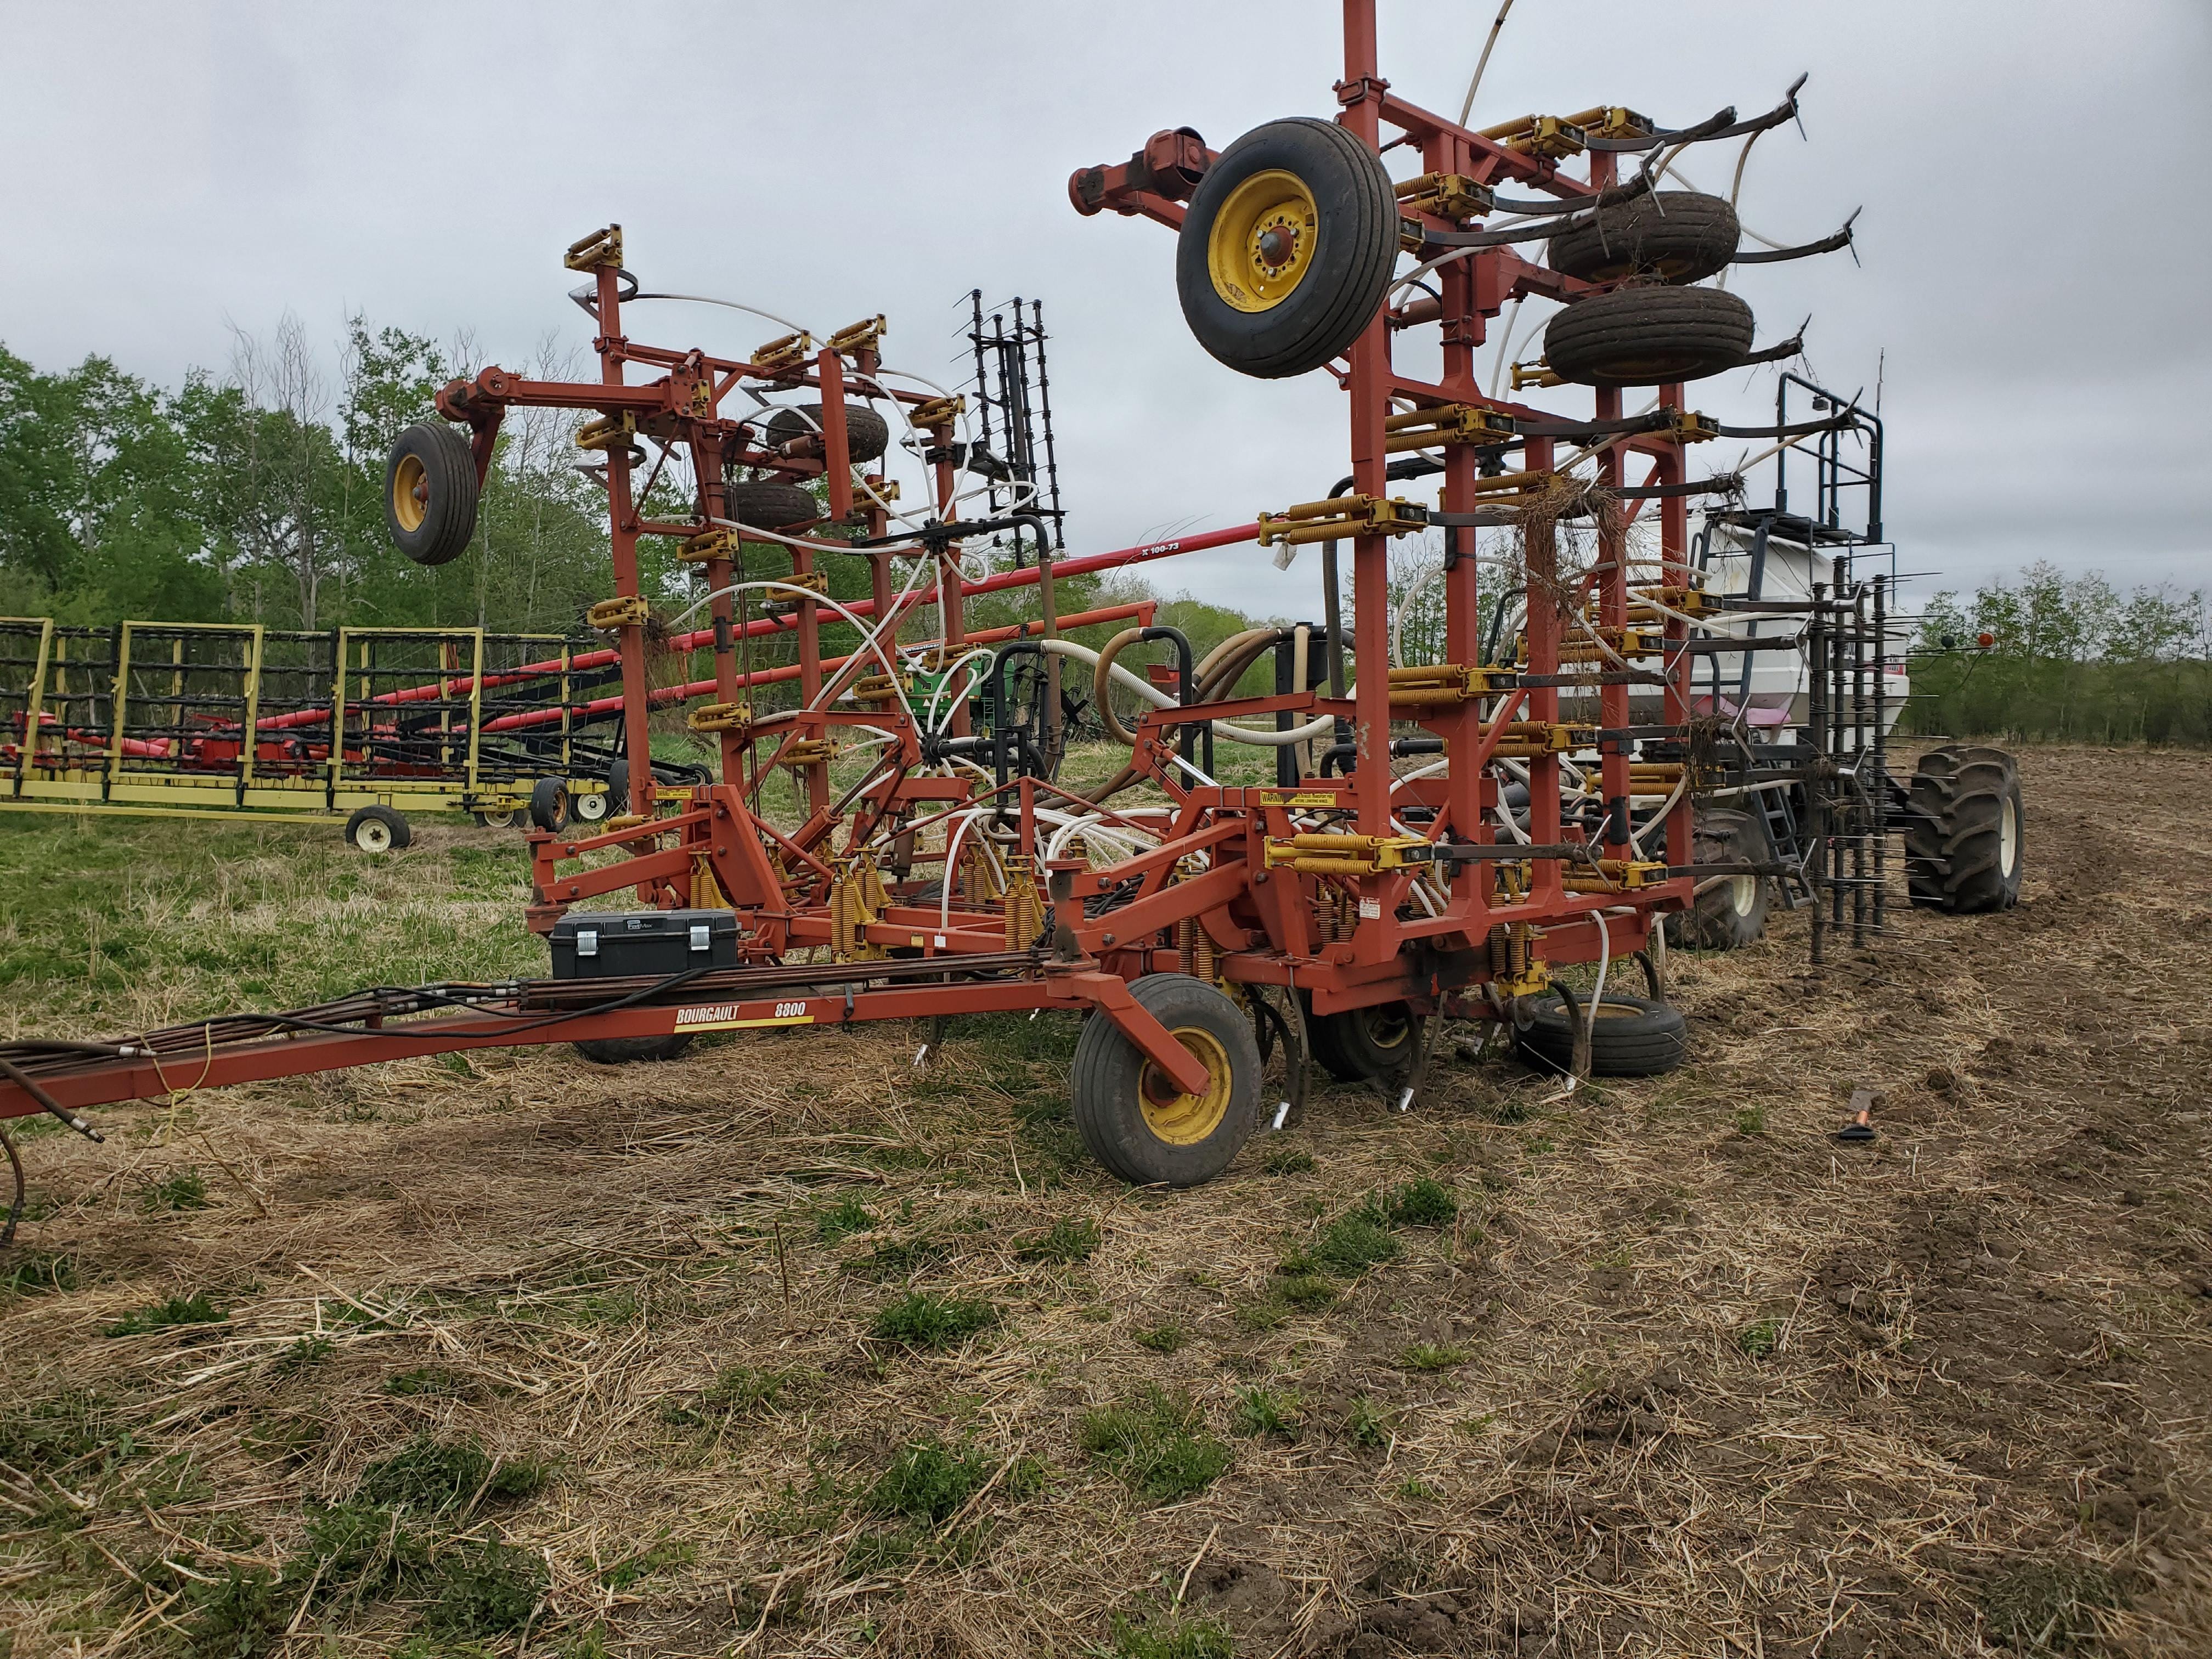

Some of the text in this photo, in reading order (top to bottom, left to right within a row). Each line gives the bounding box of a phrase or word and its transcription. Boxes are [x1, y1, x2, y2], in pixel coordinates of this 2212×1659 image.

[1150, 542, 1179, 554] 100-73
[906, 644, 940, 652] Wheathear
[1262, 793, 1284, 803] WARNIN
[675, 1002, 806, 1024] BOURGAULT 8800
